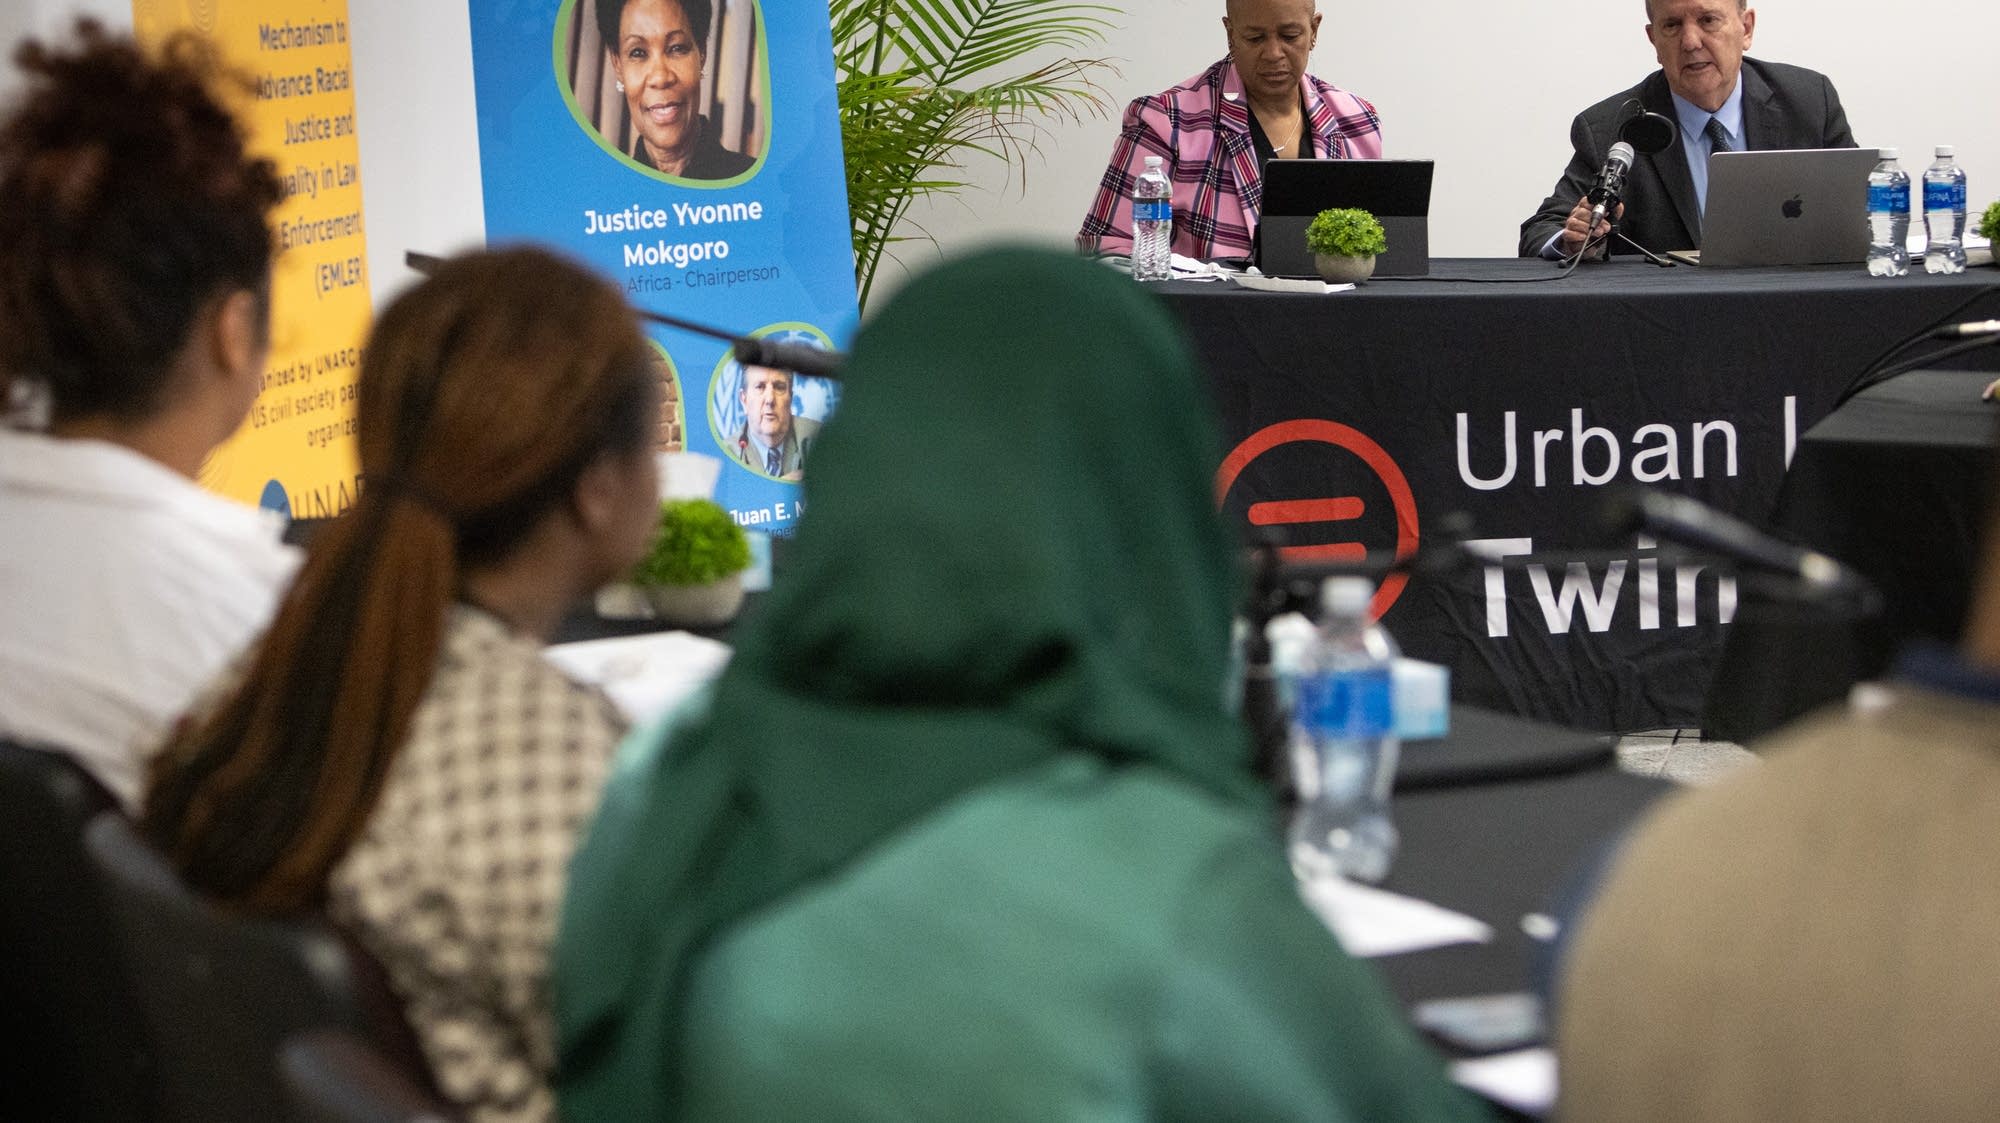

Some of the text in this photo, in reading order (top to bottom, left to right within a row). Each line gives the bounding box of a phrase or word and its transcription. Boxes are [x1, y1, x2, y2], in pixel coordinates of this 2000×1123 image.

[258, 18, 346, 50] Mechanism to
[256, 66, 350, 100] Advance Racial
[284, 107, 353, 144] Justice and
[279, 160, 357, 199] uality in Law
[281, 211, 361, 250] Enforcement
[584, 201, 763, 235] Justice Yvonne
[623, 240, 729, 269] Mokgoro
[315, 255, 366, 300] (EMLER)
[627, 274, 672, 295] Africa
[684, 266, 780, 289] Chairperson
[299, 359, 311, 384] by
[251, 404, 267, 429] US
[270, 397, 291, 423] civil
[295, 388, 335, 416] society
[1456, 407, 1738, 490] Urban
[729, 508, 771, 526] Juan
[774, 502, 791, 521] E.
[1459, 532, 1738, 638] Twin
